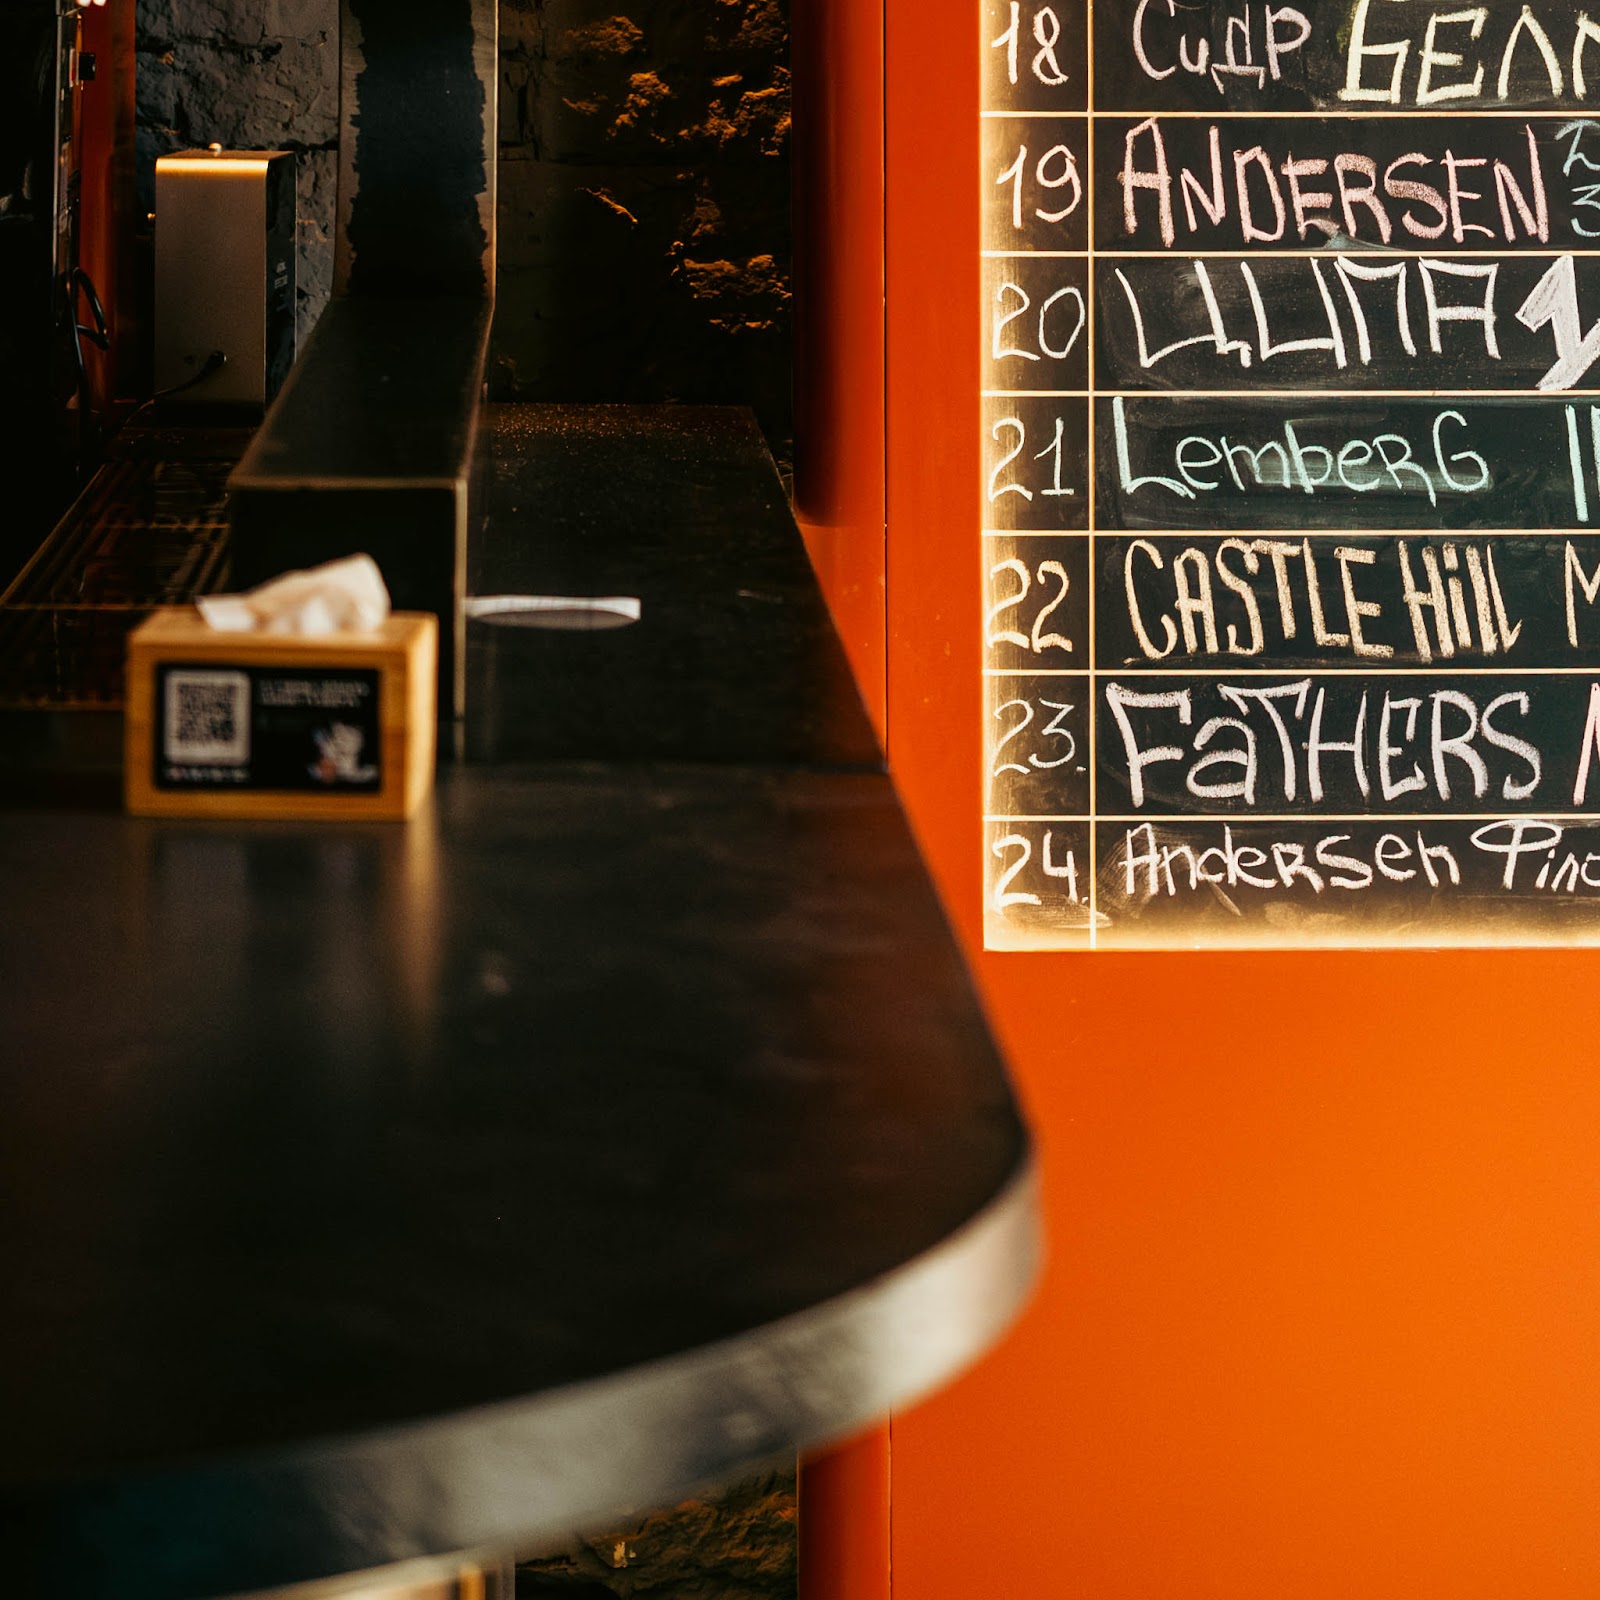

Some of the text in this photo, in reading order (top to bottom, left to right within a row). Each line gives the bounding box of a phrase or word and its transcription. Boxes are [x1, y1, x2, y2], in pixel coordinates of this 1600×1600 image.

[994, 0, 1068, 87] 18
[996, 146, 1082, 228] 19
[1119, 115, 1548, 245] ANDERSEN
[992, 282, 1085, 362] 20
[988, 414, 1074, 502] 21
[988, 562, 1071, 653] 22
[1125, 537, 1393, 663] CASTLE
